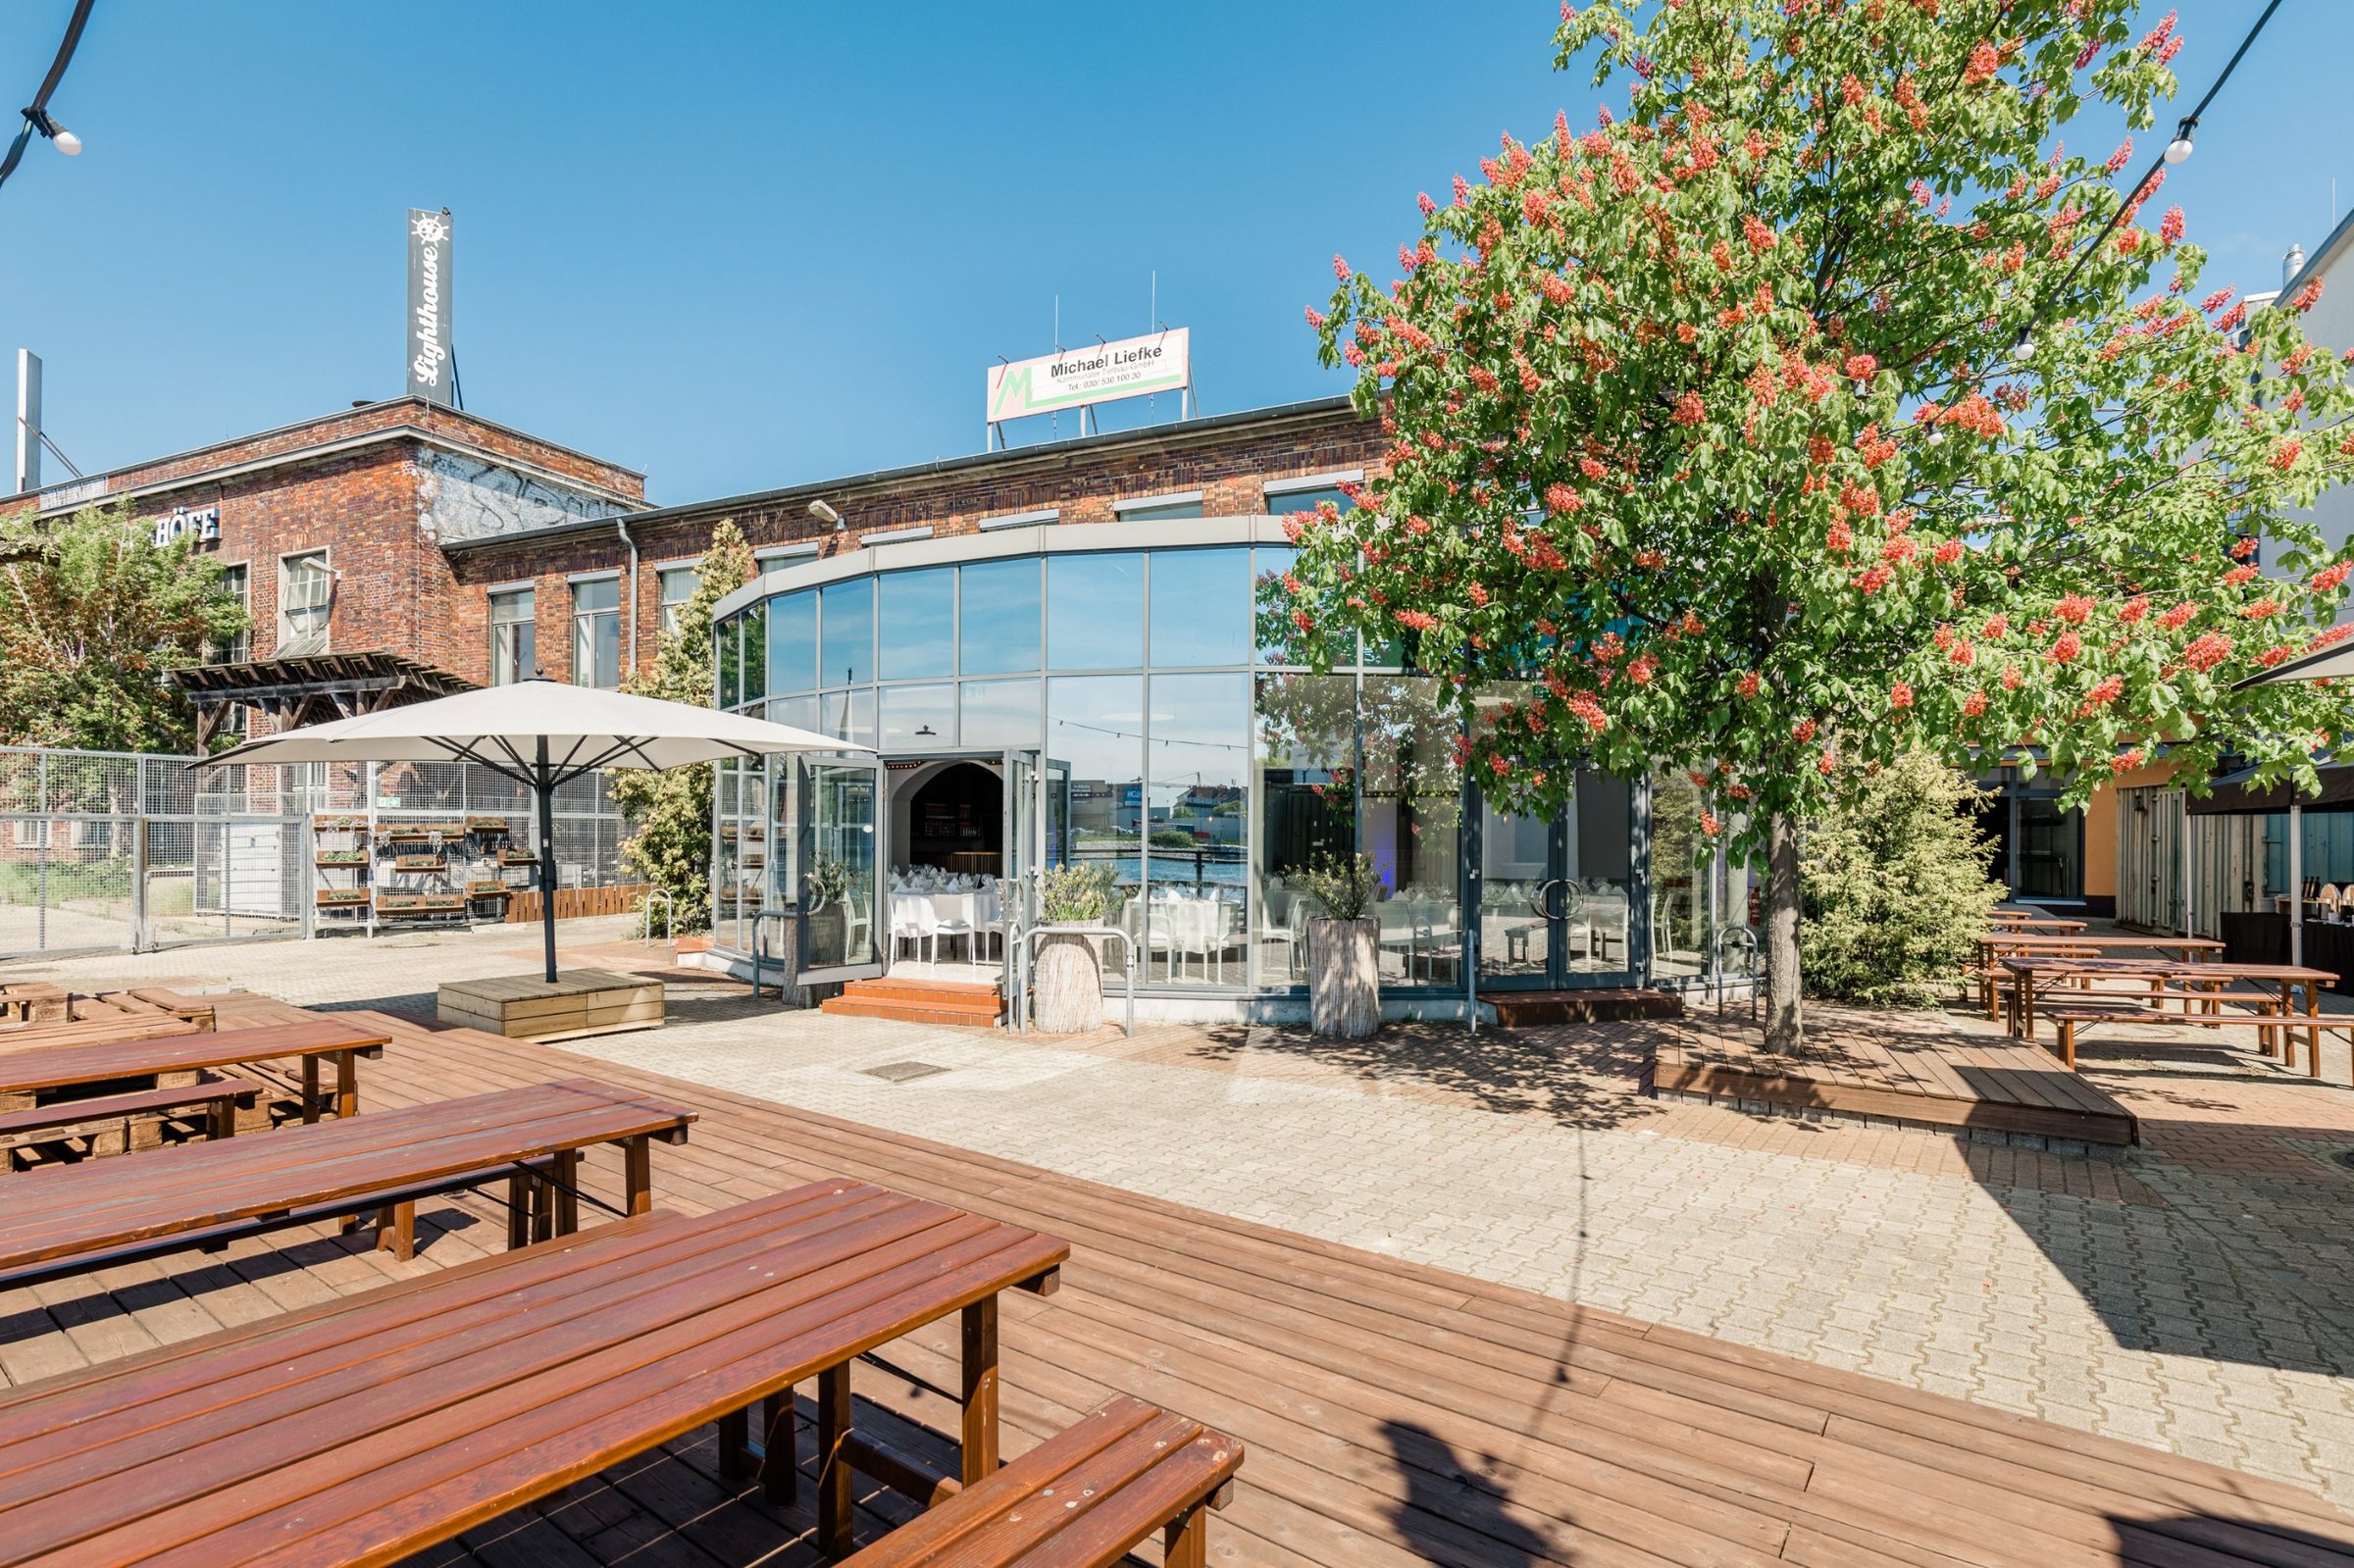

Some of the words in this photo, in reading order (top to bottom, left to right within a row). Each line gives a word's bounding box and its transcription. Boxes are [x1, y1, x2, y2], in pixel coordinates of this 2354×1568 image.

[414, 246, 445, 386] Lighthouse
[1050, 354, 1108, 378] Michael
[1114, 346, 1162, 365] Liefke
[1130, 359, 1154, 370] GmbH
[1131, 371, 1142, 380] 30
